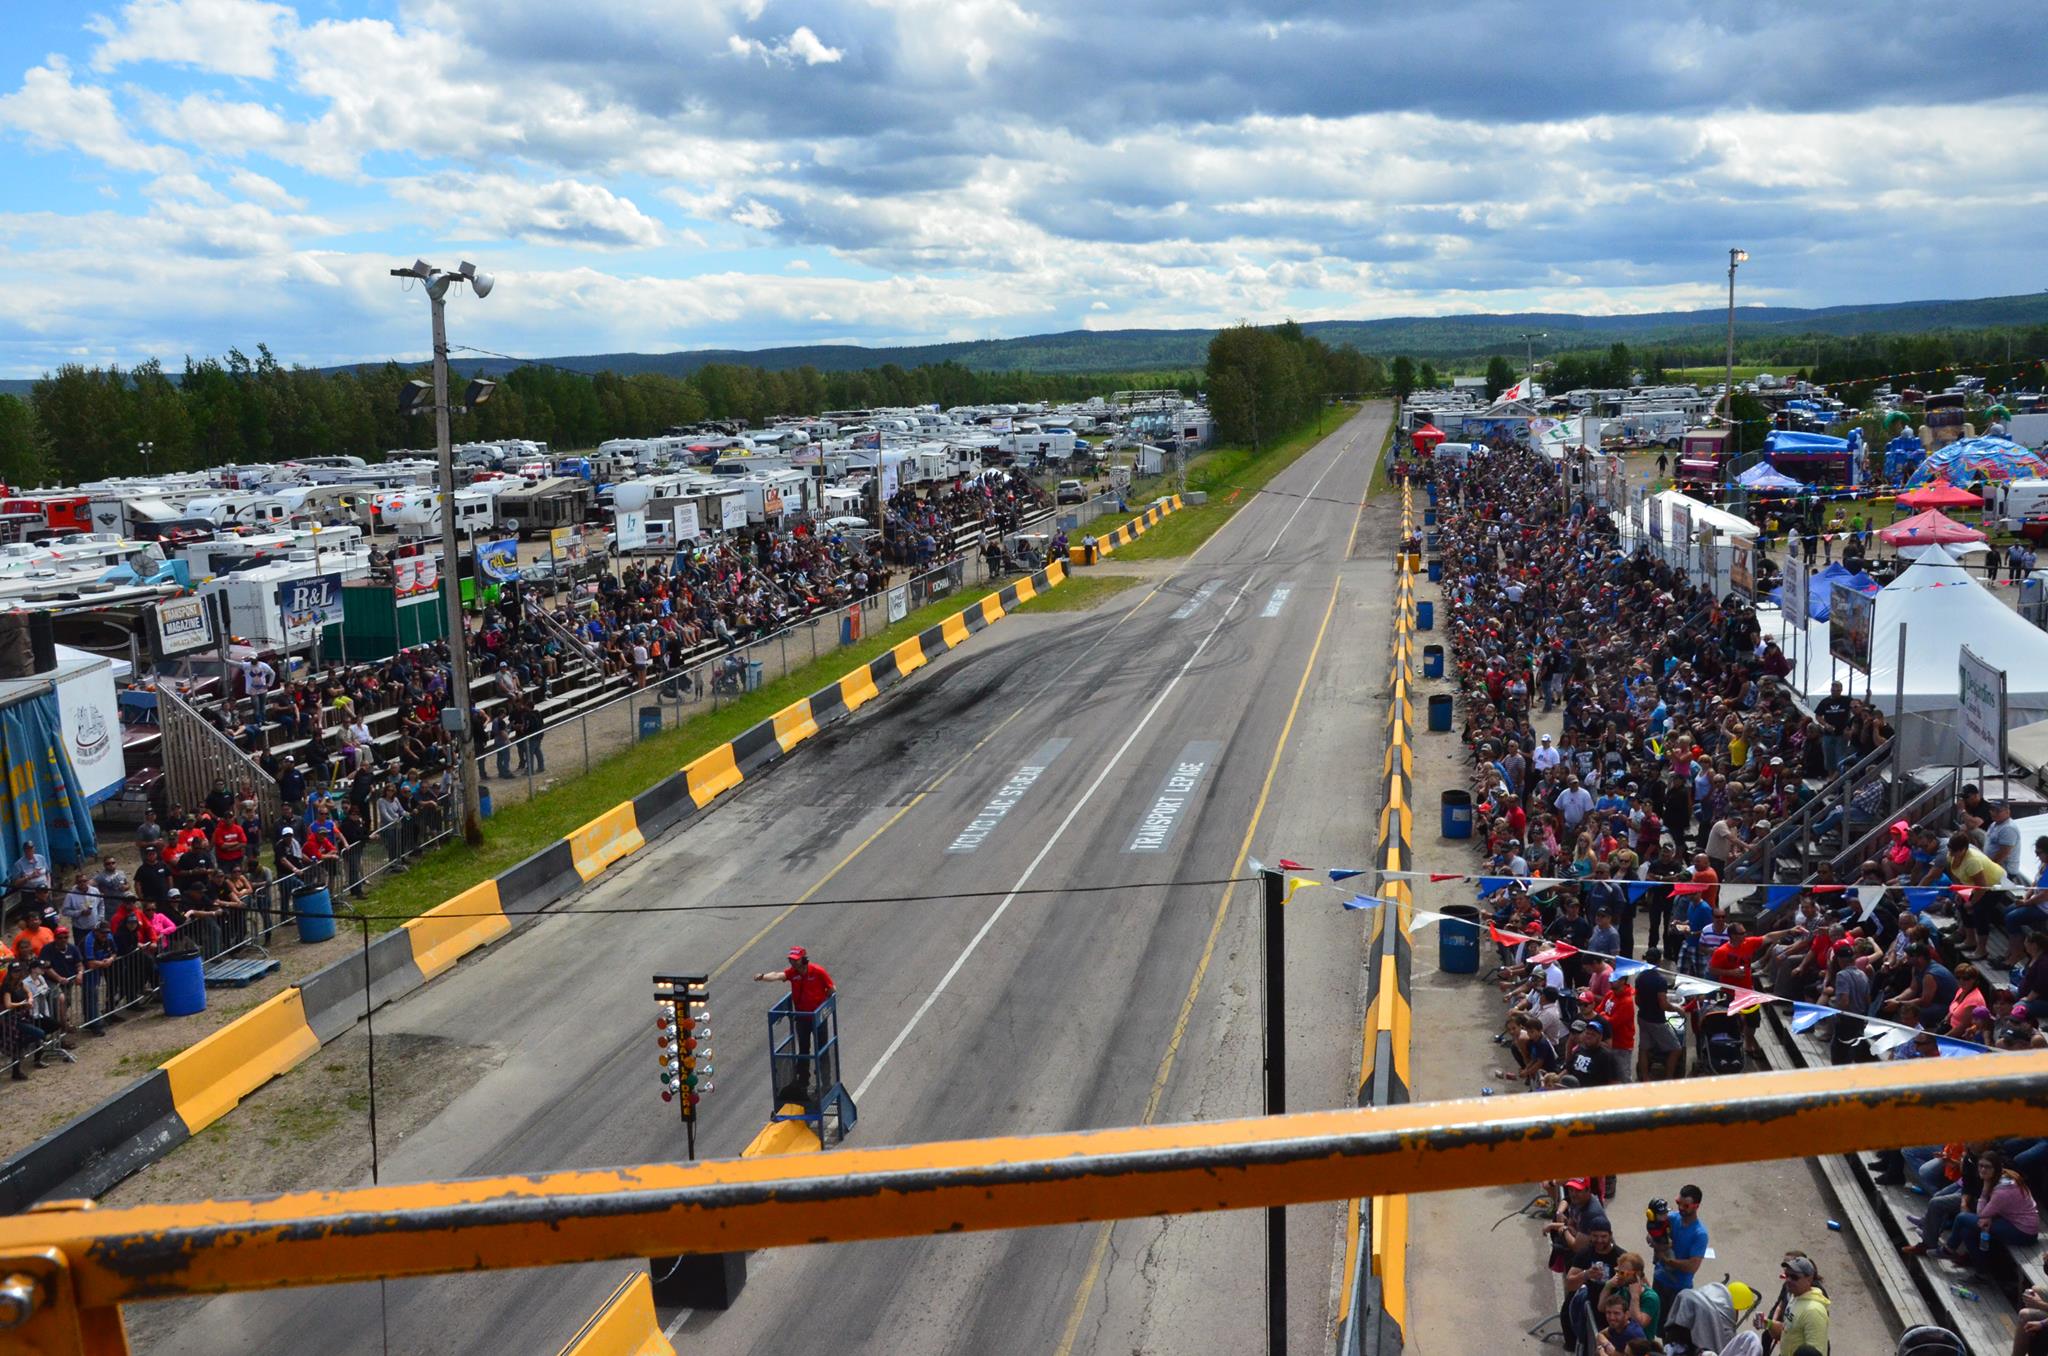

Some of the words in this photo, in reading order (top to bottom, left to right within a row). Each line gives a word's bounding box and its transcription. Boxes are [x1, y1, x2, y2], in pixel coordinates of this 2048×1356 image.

[292, 582, 333, 611] R&L
[164, 604, 198, 621] TRANSPORT
[166, 617, 201, 634] MAGAZINE
[978, 799, 1016, 817] LAC
[1129, 796, 1184, 851] TRANSPORT
[1164, 762, 1204, 793] LEPAGE
